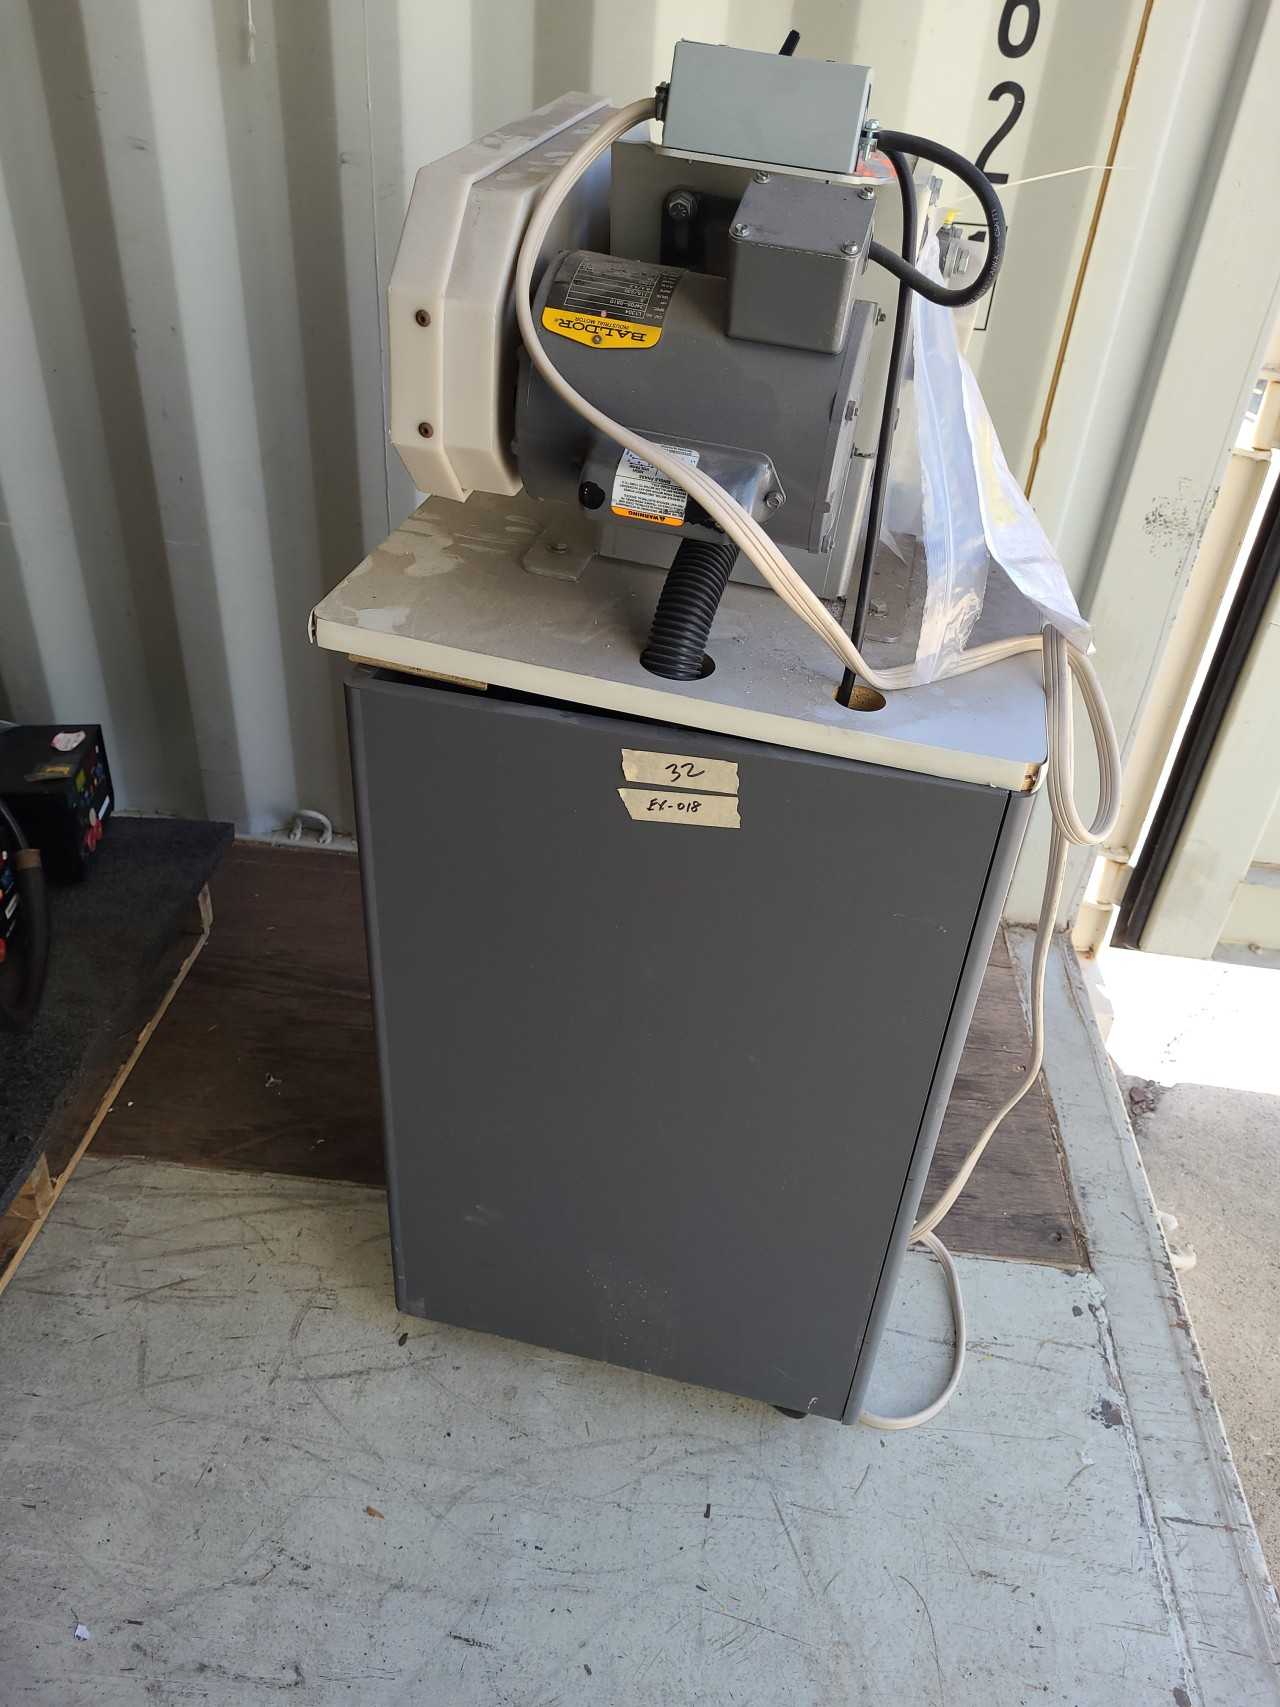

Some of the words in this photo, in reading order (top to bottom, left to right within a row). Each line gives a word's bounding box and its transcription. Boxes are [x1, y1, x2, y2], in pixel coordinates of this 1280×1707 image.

[574, 316, 595, 325] MOTOR
[557, 317, 647, 343] BALDOR
[628, 510, 659, 521] WARNING
[665, 762, 705, 782] 32
[646, 797, 702, 813] EX-018
